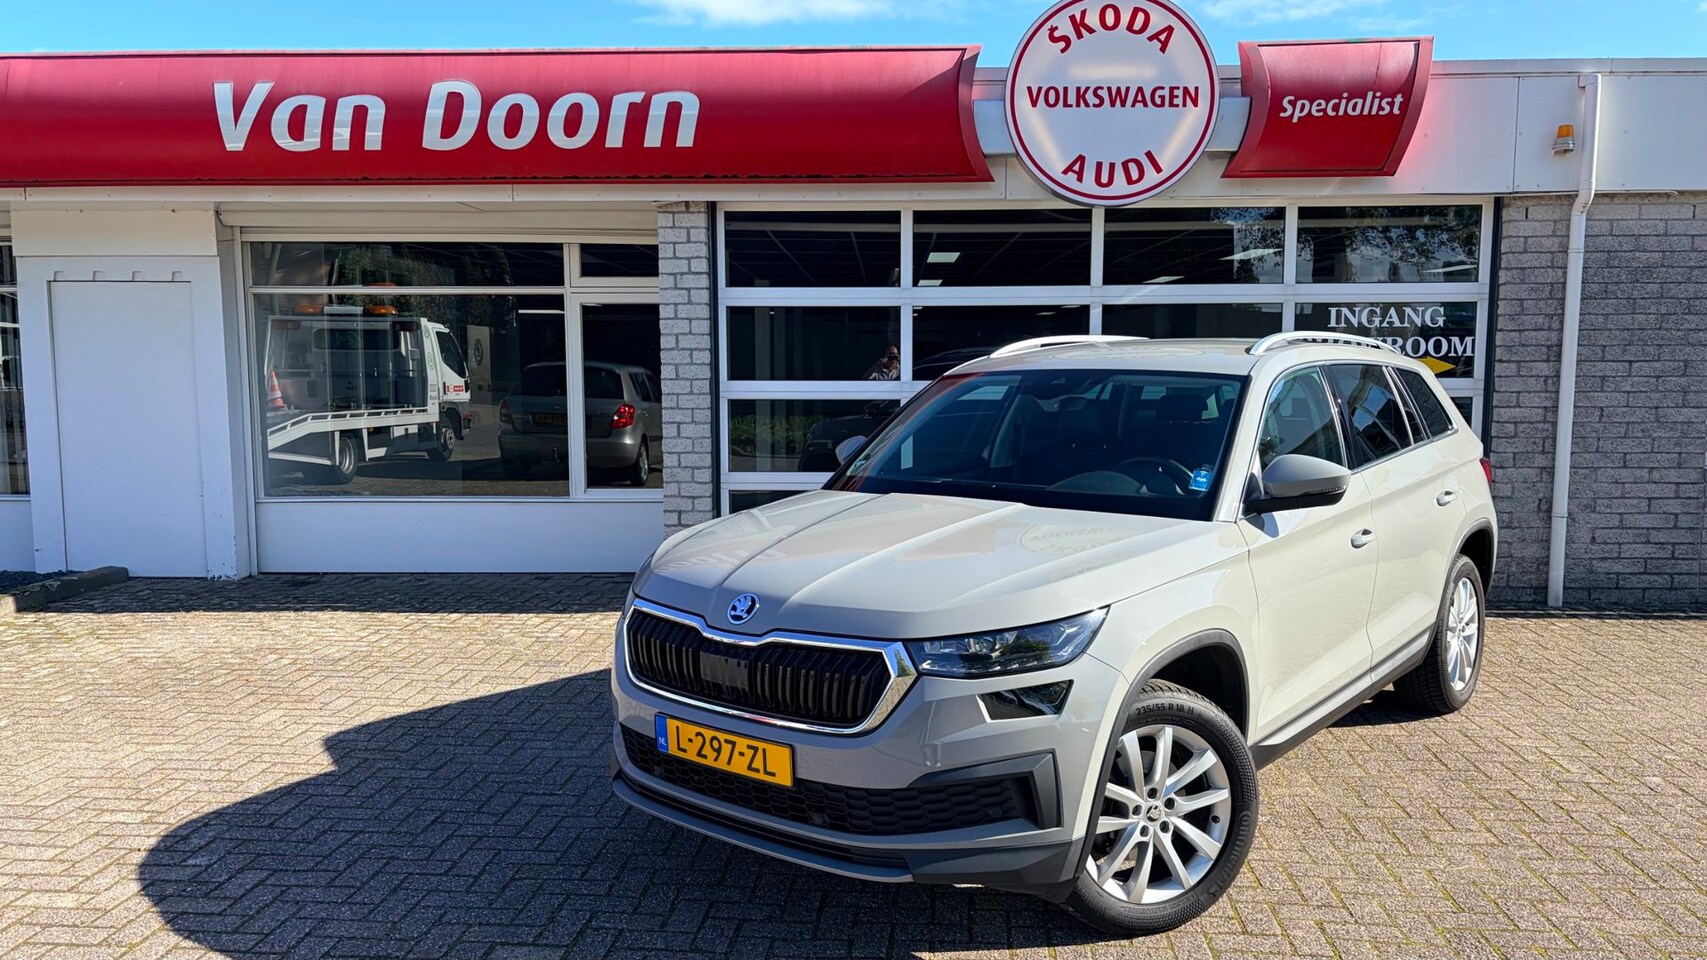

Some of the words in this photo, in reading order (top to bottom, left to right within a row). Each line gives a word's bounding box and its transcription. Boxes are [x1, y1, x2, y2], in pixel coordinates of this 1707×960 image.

[1047, 3, 1175, 54] ŠKODA
[1026, 86, 1199, 108] VOLKSWAGEN
[1279, 91, 1404, 123] Specialist
[213, 80, 386, 152] Van
[422, 79, 700, 150] Doorn
[1061, 149, 1164, 188] AUDI
[1327, 306, 1446, 328] INGANG
[1135, 702, 1166, 716] 235/55
[1168, 703, 1174, 712] R
[1176, 703, 1185, 713] 18
[658, 736, 667, 747] NL
[675, 725, 777, 777] L-297-ZL
